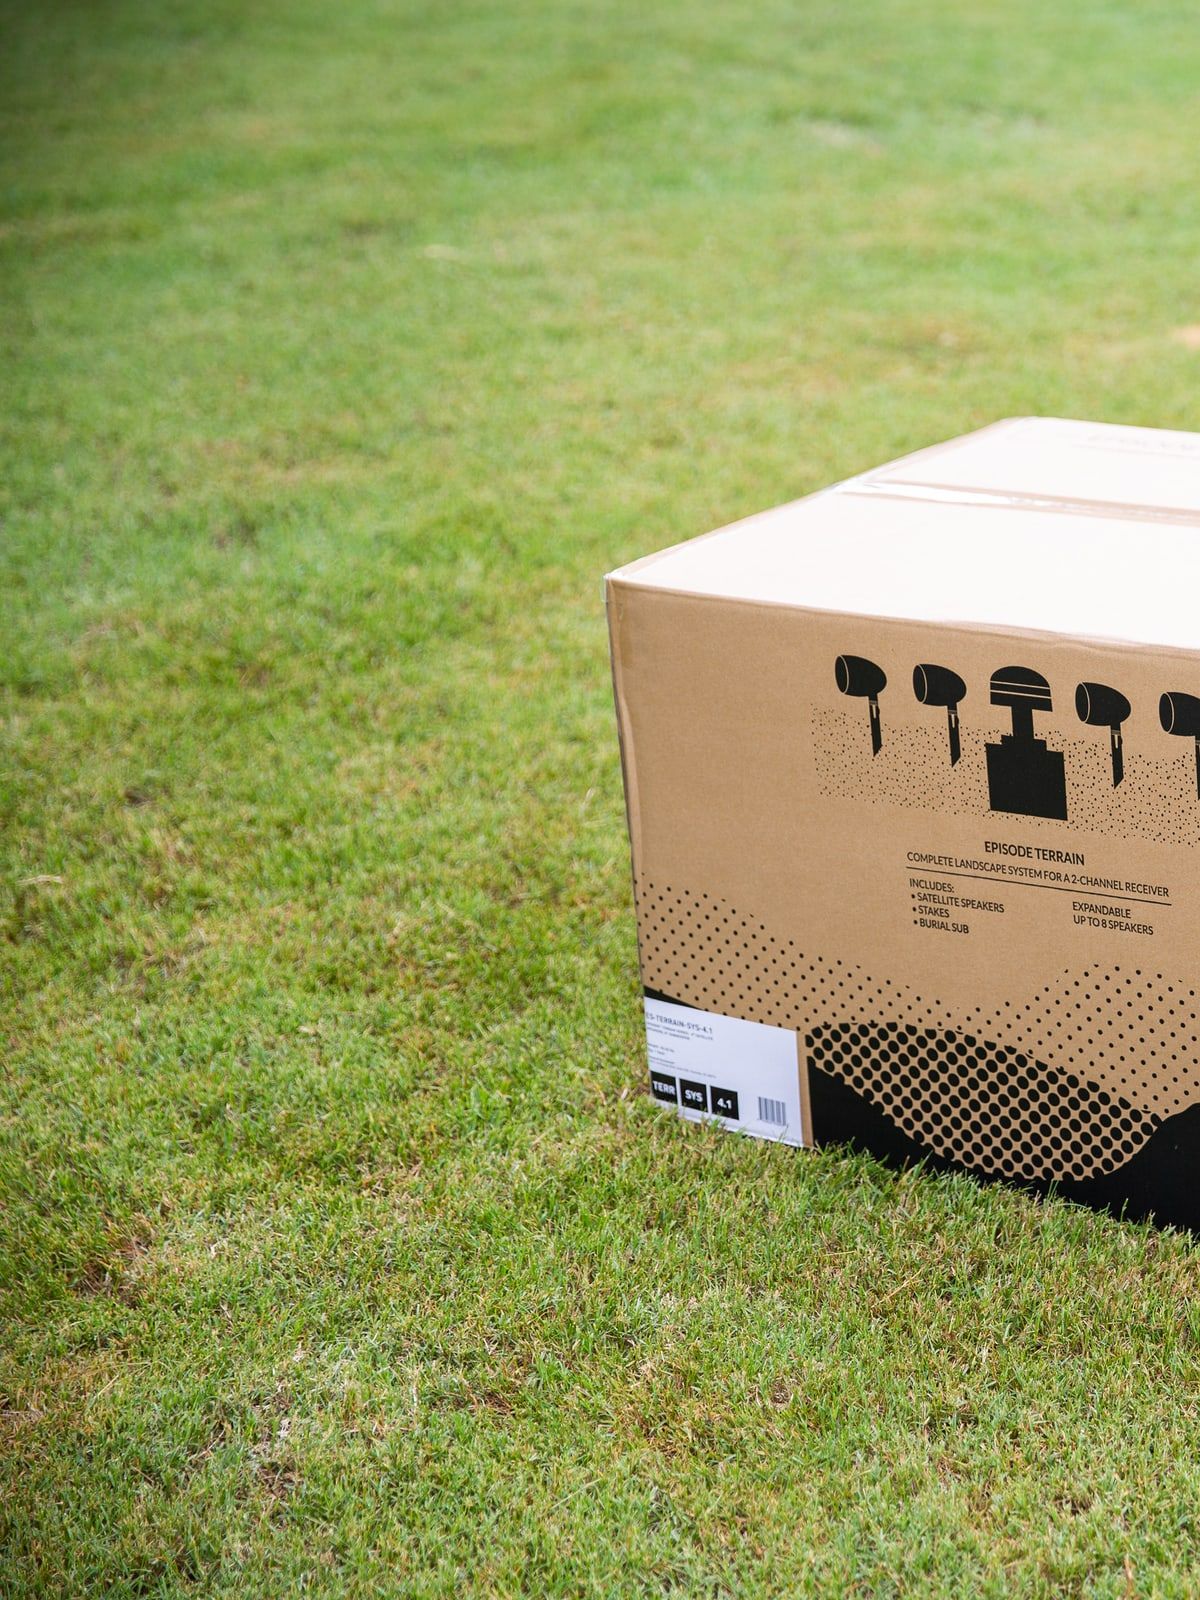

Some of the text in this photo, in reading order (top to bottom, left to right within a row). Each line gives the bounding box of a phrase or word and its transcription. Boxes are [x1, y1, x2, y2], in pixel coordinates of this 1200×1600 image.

[984, 841, 1085, 866] EPISODE TERRAIN
[907, 851, 1170, 897] COMPLETE LANDSCAPE SYSTEM FOR A 2-CHANNEL RECEIVER
[909, 878, 954, 893] INCLUDES:
[917, 892, 1005, 913] SATELLITE SPEAKERS
[1072, 901, 1131, 919] EXPANDABLE
[918, 905, 950, 918] STAKES
[919, 918, 969, 934] BURIAL SUB
[1073, 915, 1154, 936] UP TO 8 SPEAKERS
[685, 1089, 703, 1102] SYS
[717, 1097, 732, 1109] 4.1
